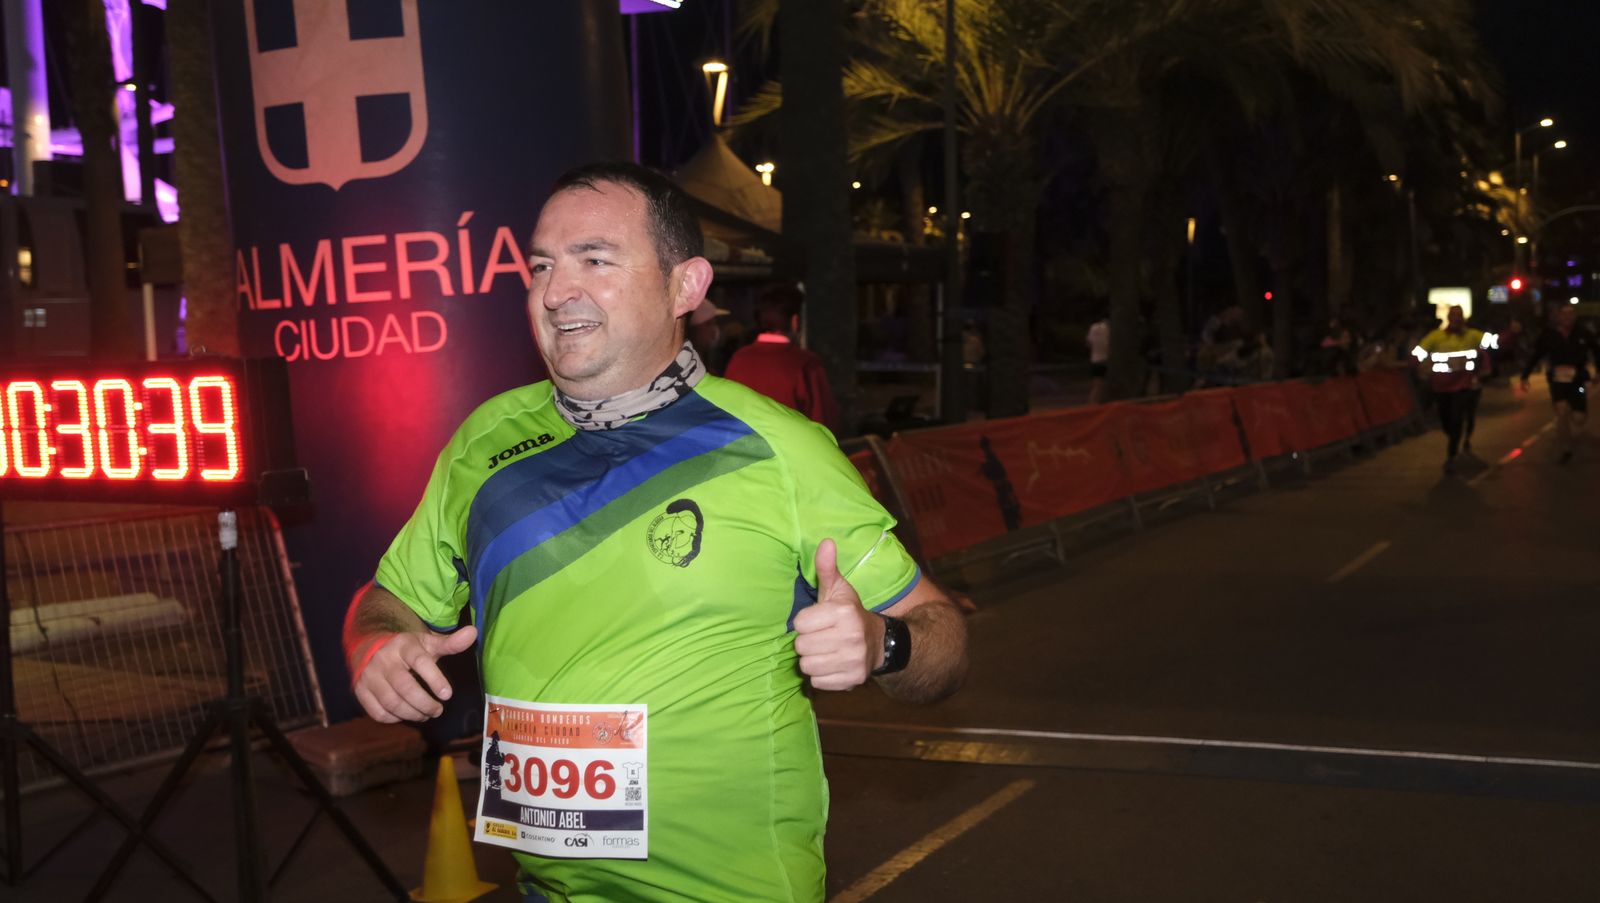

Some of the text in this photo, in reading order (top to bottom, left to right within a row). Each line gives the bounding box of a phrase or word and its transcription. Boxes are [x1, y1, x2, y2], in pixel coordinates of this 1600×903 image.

[236, 211, 532, 310] ALMERÍA
[274, 311, 447, 361] CIUDAD
[0, 376, 238, 480] 0:30:39
[488, 433, 555, 469] Joma
[541, 714, 591, 725] BOMBEROS
[544, 725, 580, 737] CIUDAD
[504, 752, 616, 800] 3096
[520, 806, 586, 829] ANTONIO ABEL
[564, 837, 588, 848] CASI
[602, 835, 640, 847] formas
